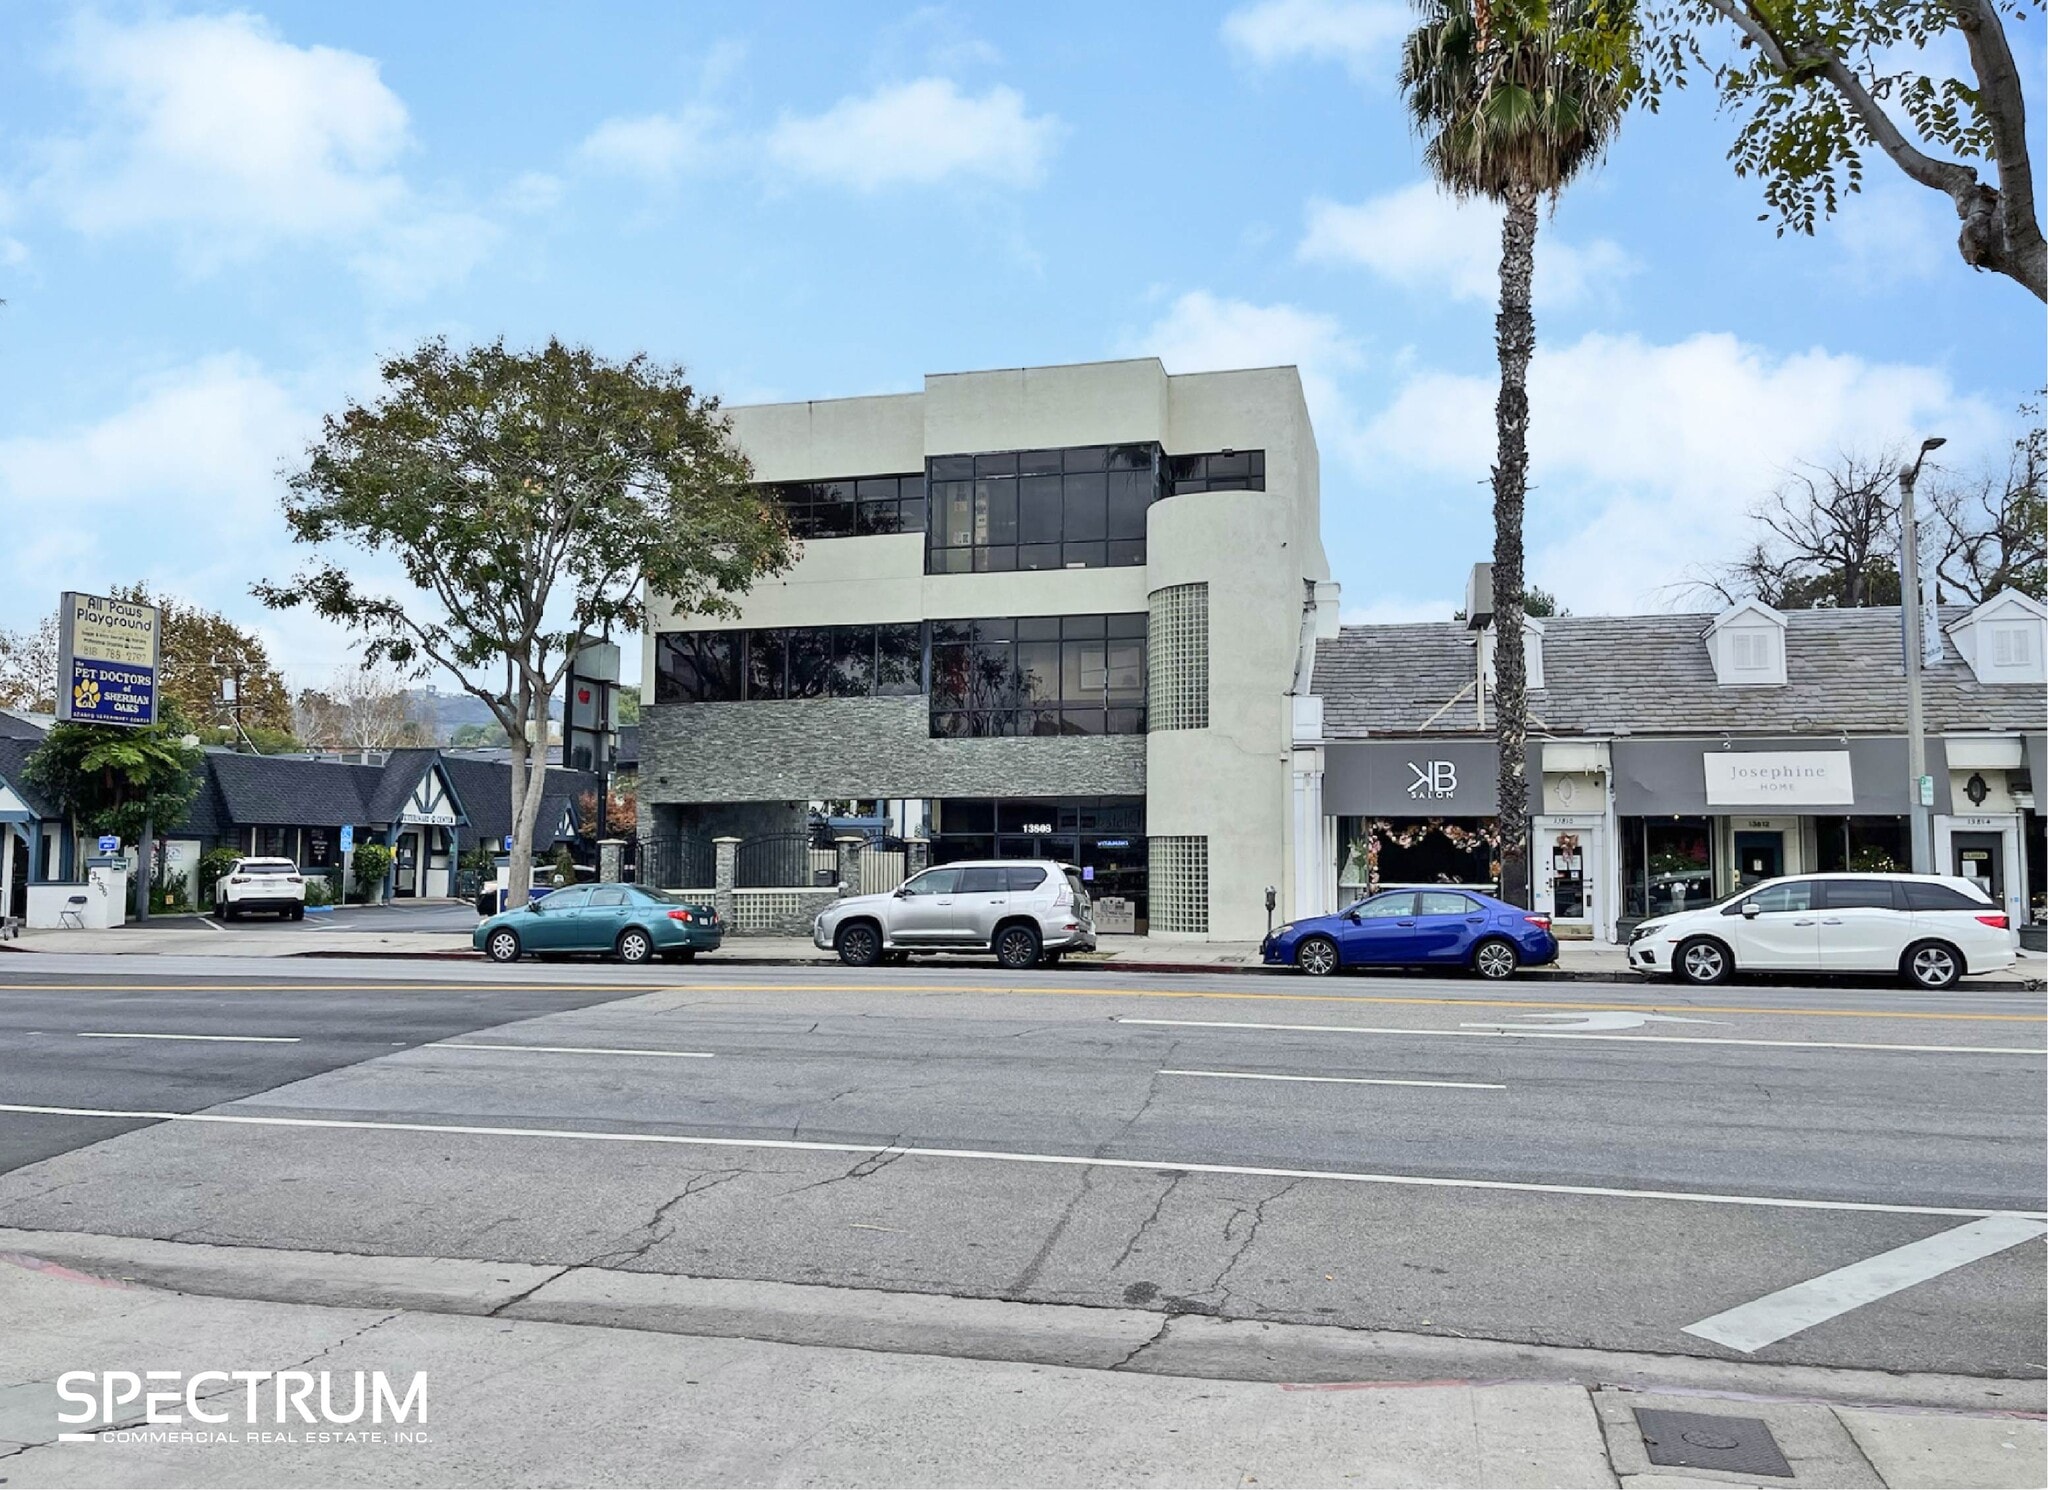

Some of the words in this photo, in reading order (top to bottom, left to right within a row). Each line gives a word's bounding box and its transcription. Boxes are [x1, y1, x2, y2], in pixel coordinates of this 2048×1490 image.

[88, 597, 103, 611] All
[109, 601, 143, 618] Paws
[77, 608, 152, 632] Playground
[75, 667, 98, 680] PET
[99, 669, 152, 686] DOCTORS
[123, 685, 132, 693] of
[103, 692, 150, 705] SHERMAN
[114, 702, 140, 714] OAKS
[1407, 760, 1458, 792] KB
[1731, 765, 1825, 780] Josephine
[1760, 783, 1796, 791] HOME
[1411, 791, 1454, 799] SALON
